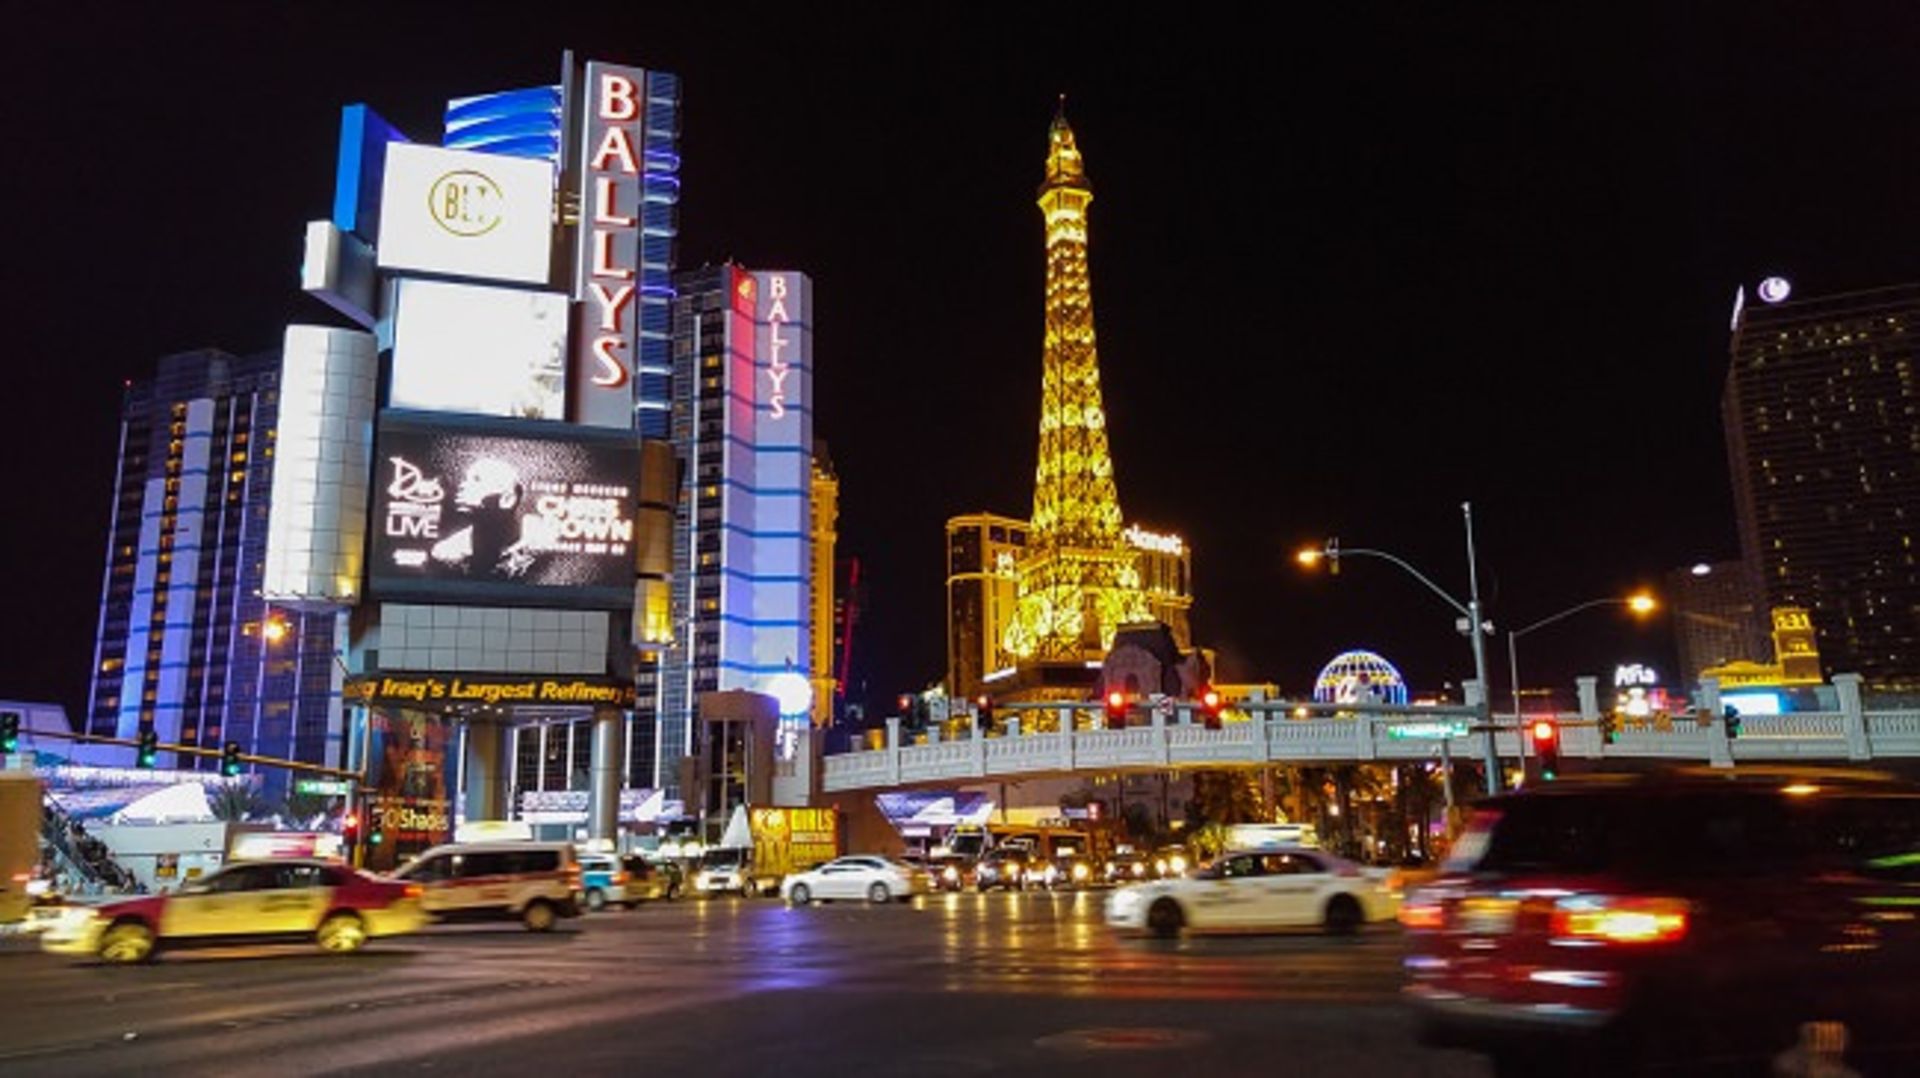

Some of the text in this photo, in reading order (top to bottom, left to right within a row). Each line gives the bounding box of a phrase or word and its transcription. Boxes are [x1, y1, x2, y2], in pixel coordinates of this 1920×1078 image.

[589, 73, 640, 388] BALLYS
[767, 276, 790, 419] BALLYS
[387, 515, 438, 538] LIVE
[381, 678, 446, 701] Iraq's
[451, 679, 536, 703] Largest
[400, 807, 449, 830] Shades
